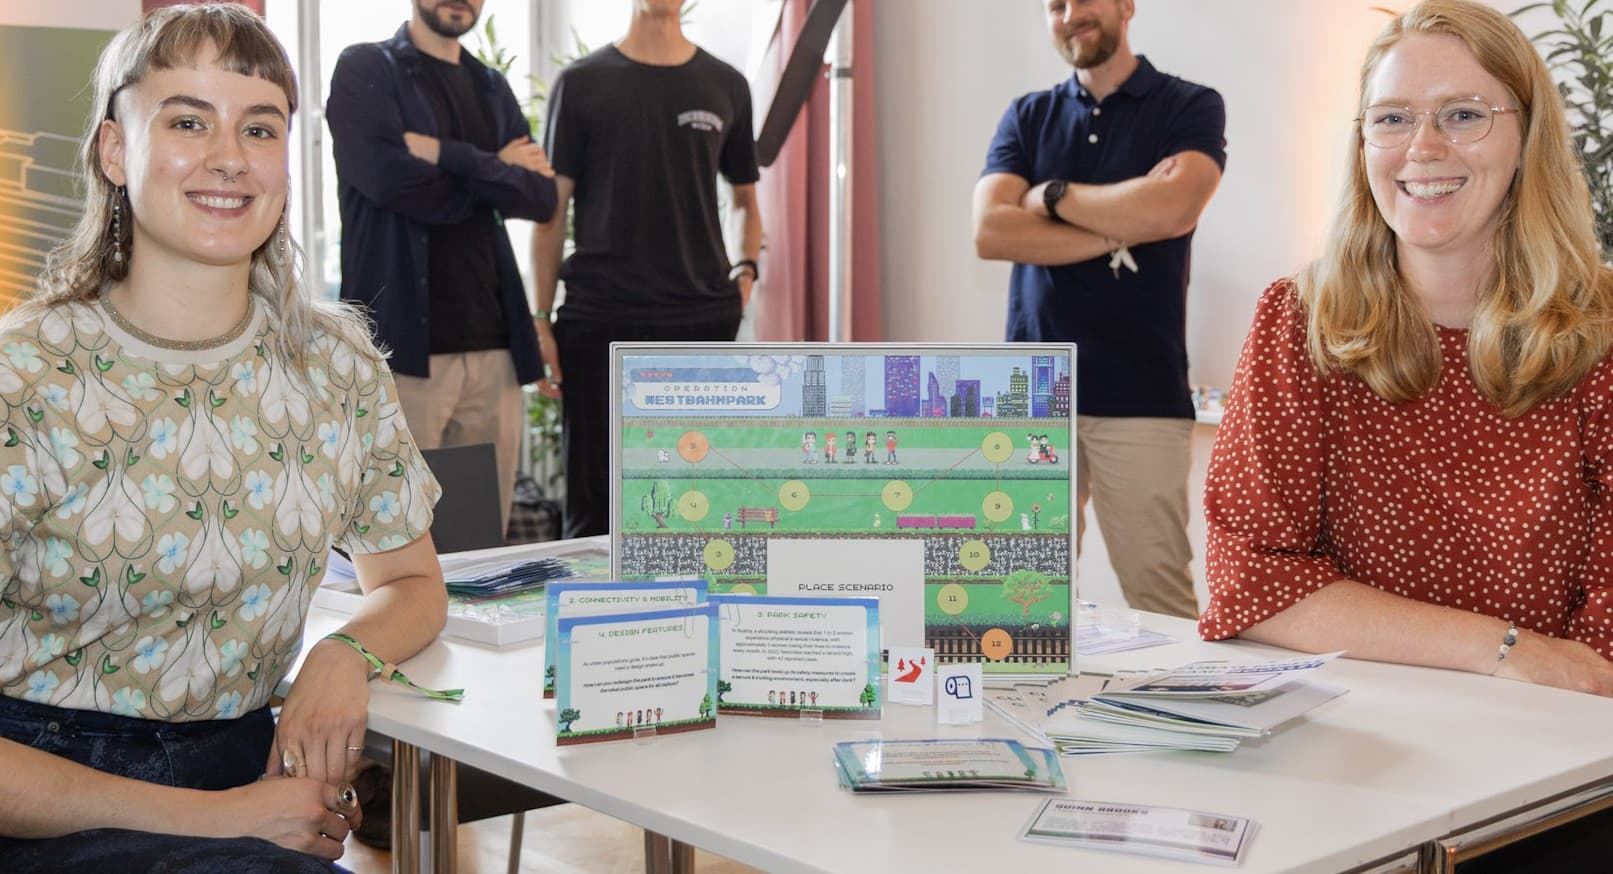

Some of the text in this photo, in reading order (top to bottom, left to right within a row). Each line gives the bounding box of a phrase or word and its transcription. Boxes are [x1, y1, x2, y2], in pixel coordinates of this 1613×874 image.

[798, 583, 894, 591] PLACE SCENARIO
[649, 594, 688, 602] MOBILITY
[948, 594, 957, 602] 11
[608, 628, 640, 638] DESIGN
[642, 624, 684, 635] FEATURES
[991, 640, 1002, 648] 12
